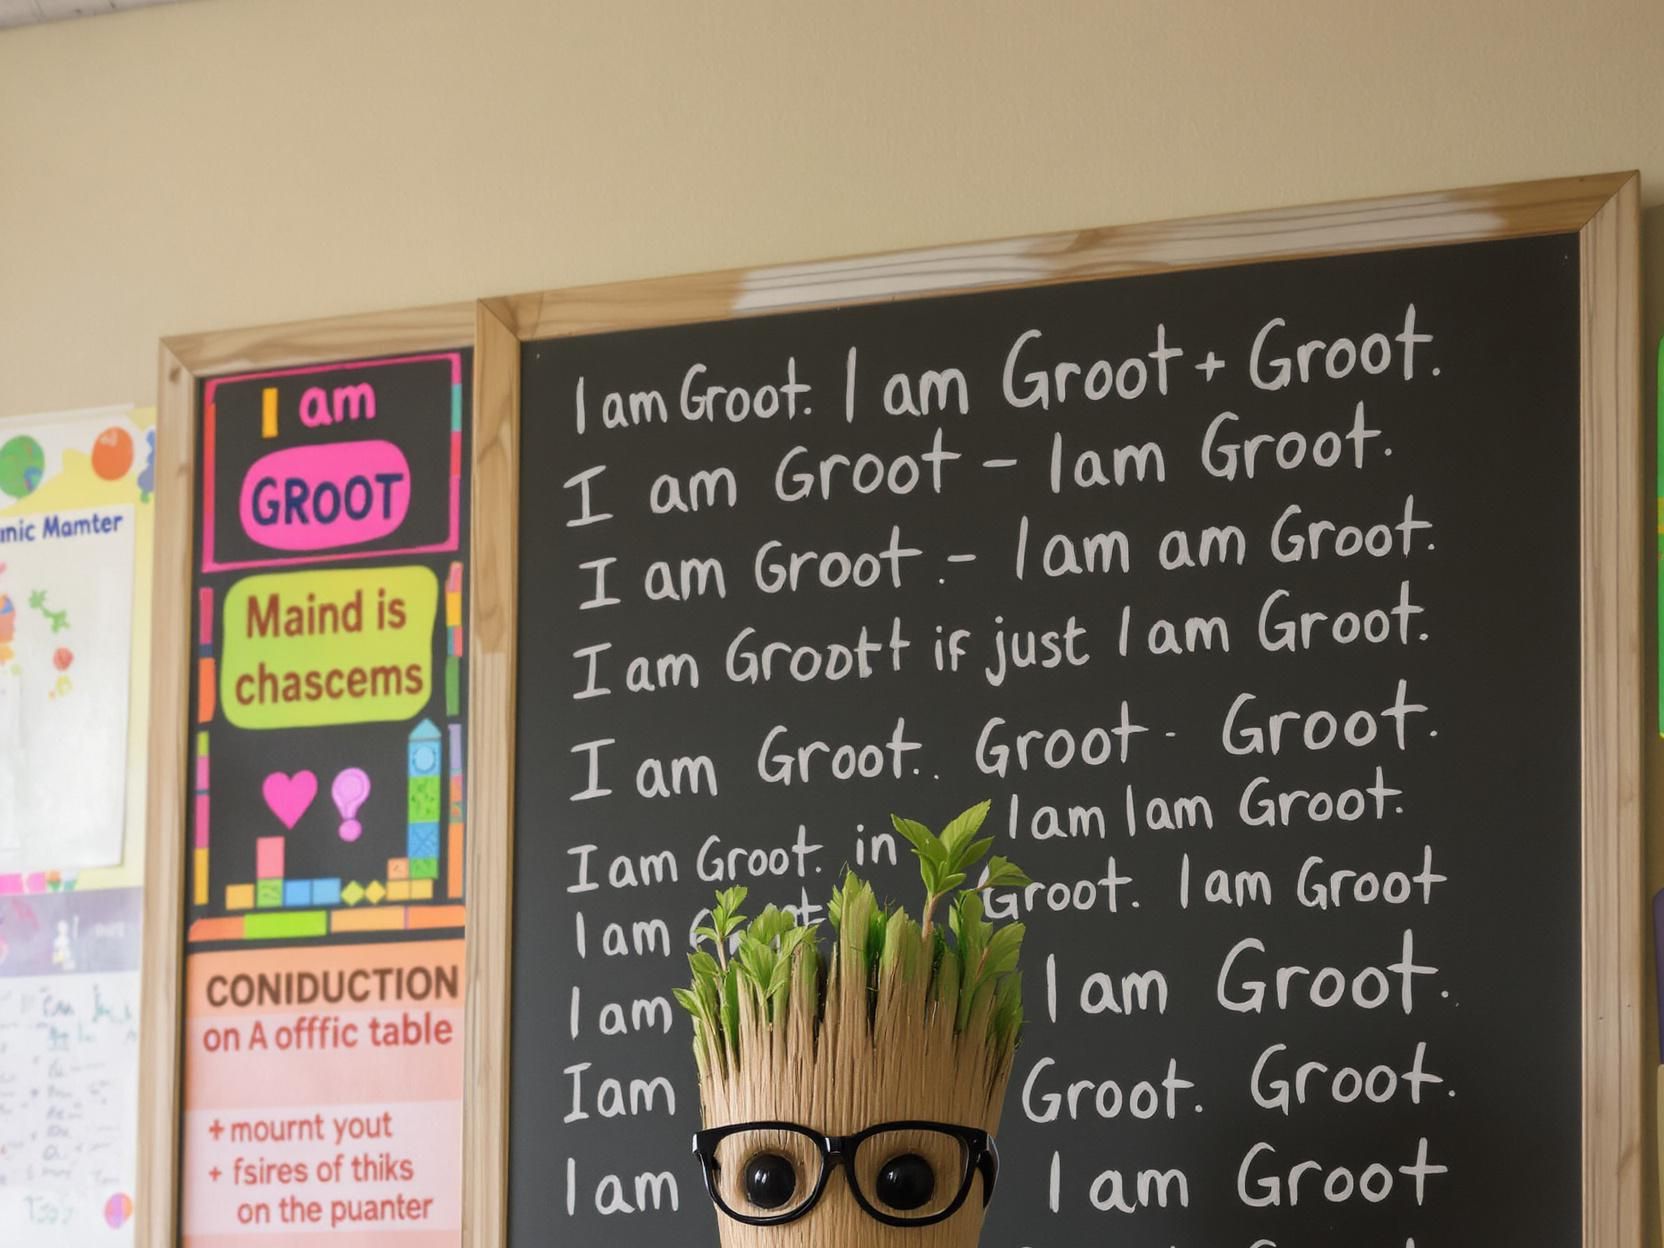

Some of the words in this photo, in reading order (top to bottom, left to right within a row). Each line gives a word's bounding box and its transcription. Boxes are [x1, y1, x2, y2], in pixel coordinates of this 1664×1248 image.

[601, 389, 669, 430] am
[679, 355, 813, 426] Groot.
[846, 347, 856, 422] I
[882, 367, 970, 418] am
[1001, 322, 1185, 411] Groot
[1248, 302, 1442, 392] Groot.
[262, 388, 278, 438] I
[299, 382, 376, 427] am
[564, 466, 613, 527] I
[648, 466, 738, 515] am
[774, 426, 963, 503] Groot
[1200, 399, 1393, 482] Groot.
[252, 473, 404, 525] GROOT
[579, 558, 620, 609] I
[643, 557, 728, 602] am
[1157, 524, 1247, 572] am
[1269, 493, 1436, 564] Groot.
[247, 588, 364, 638] Maind
[377, 587, 407, 630] is
[573, 643, 611, 699] I
[624, 652, 700, 694] am
[984, 614, 1091, 688] just
[1257, 579, 1430, 653] Groot.
[235, 662, 424, 706] chascems
[570, 739, 615, 801] I
[634, 754, 719, 800] am
[974, 699, 1150, 780] Groot
[1221, 677, 1439, 756] Groot.
[695, 823, 824, 883] Groot.
[855, 822, 898, 867] in
[1238, 765, 1404, 828] Groot.
[1295, 843, 1449, 912] Groot
[206, 965, 459, 1007] CONIDUCTION
[1047, 954, 1056, 1023] I
[1079, 968, 1169, 1017] am
[1216, 927, 1450, 1016] Groot.
[203, 1027, 240, 1052] on
[249, 1020, 268, 1050] A
[369, 1011, 453, 1046] table
[1020, 1055, 1204, 1125] Groot.
[1249, 1040, 1457, 1117] Groot.
[230, 1114, 325, 1143] mournt
[333, 1111, 393, 1145] yout
[233, 1157, 308, 1185] fsires
[316, 1153, 344, 1182] of
[350, 1152, 415, 1182] thiks
[1050, 1151, 1060, 1213] I
[1088, 1167, 1190, 1215] am
[1236, 1136, 1449, 1208] Groot
[237, 1202, 270, 1224] on
[278, 1195, 322, 1223] the
[331, 1193, 433, 1228] puanter
